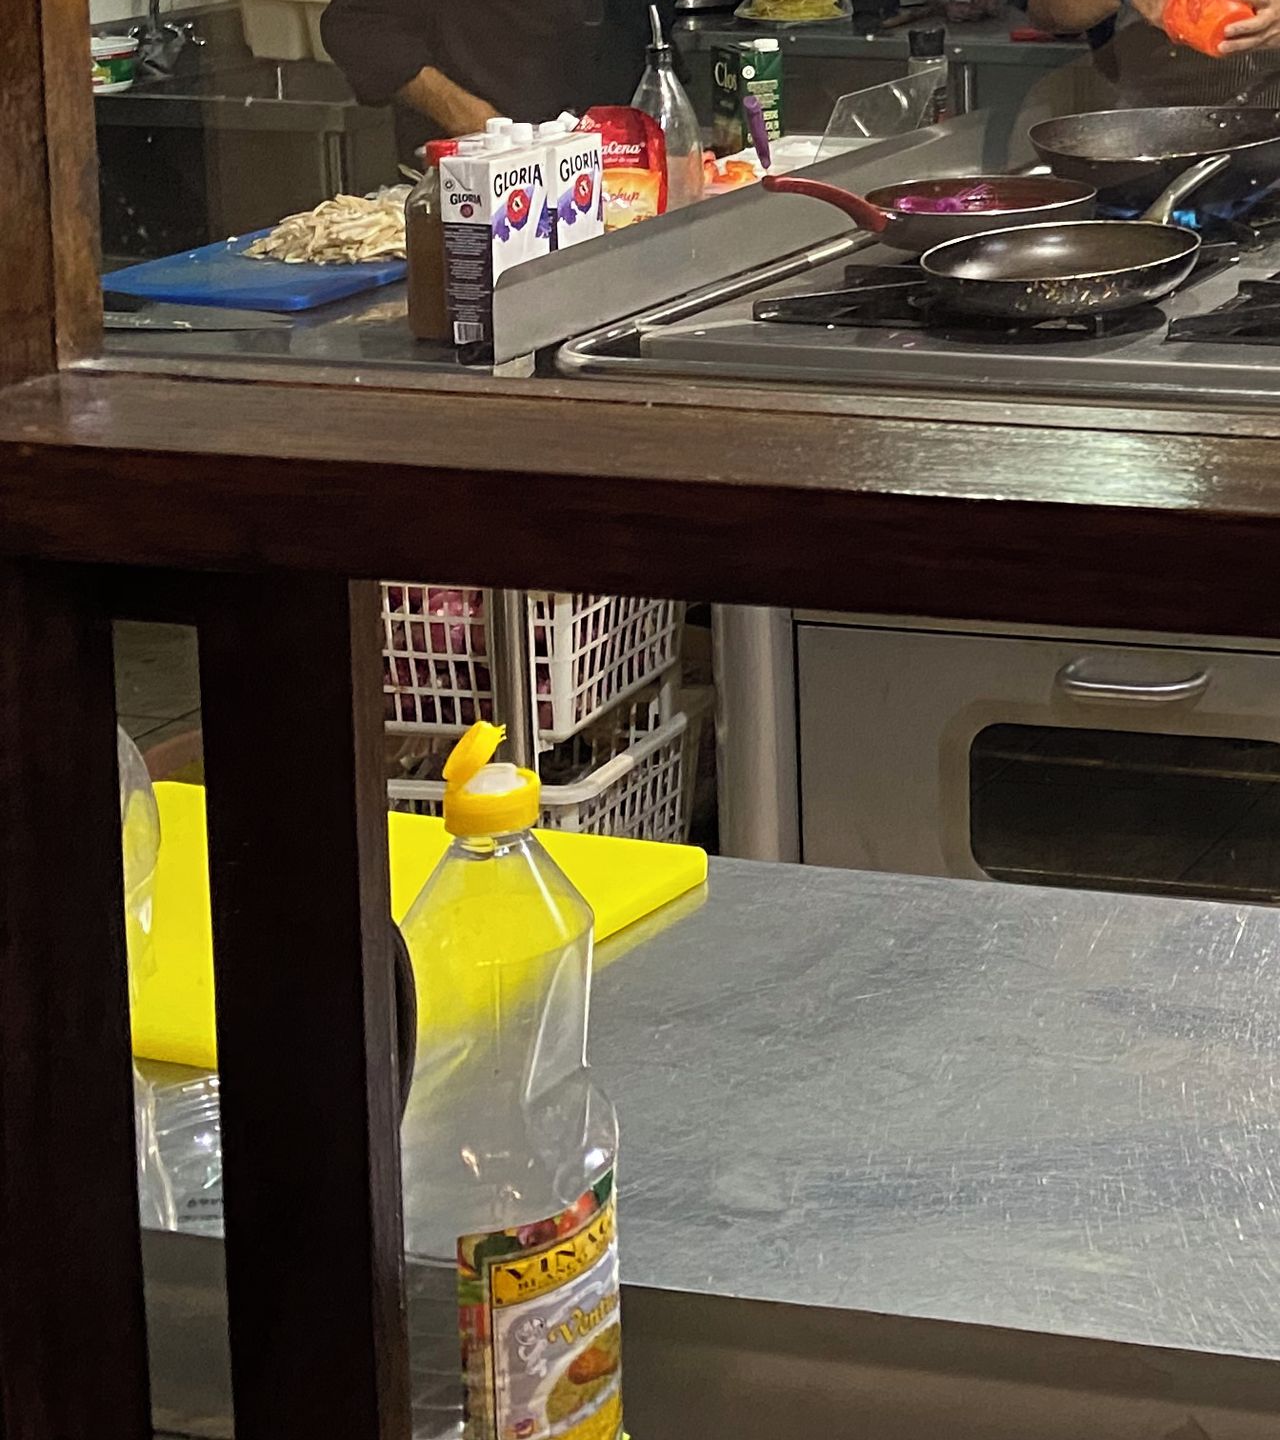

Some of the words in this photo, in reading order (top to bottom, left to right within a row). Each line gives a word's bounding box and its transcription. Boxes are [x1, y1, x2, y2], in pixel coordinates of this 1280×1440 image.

[493, 163, 543, 197] GLORIA
[559, 149, 600, 182] GLORIA
[450, 193, 481, 207] GLORIA
